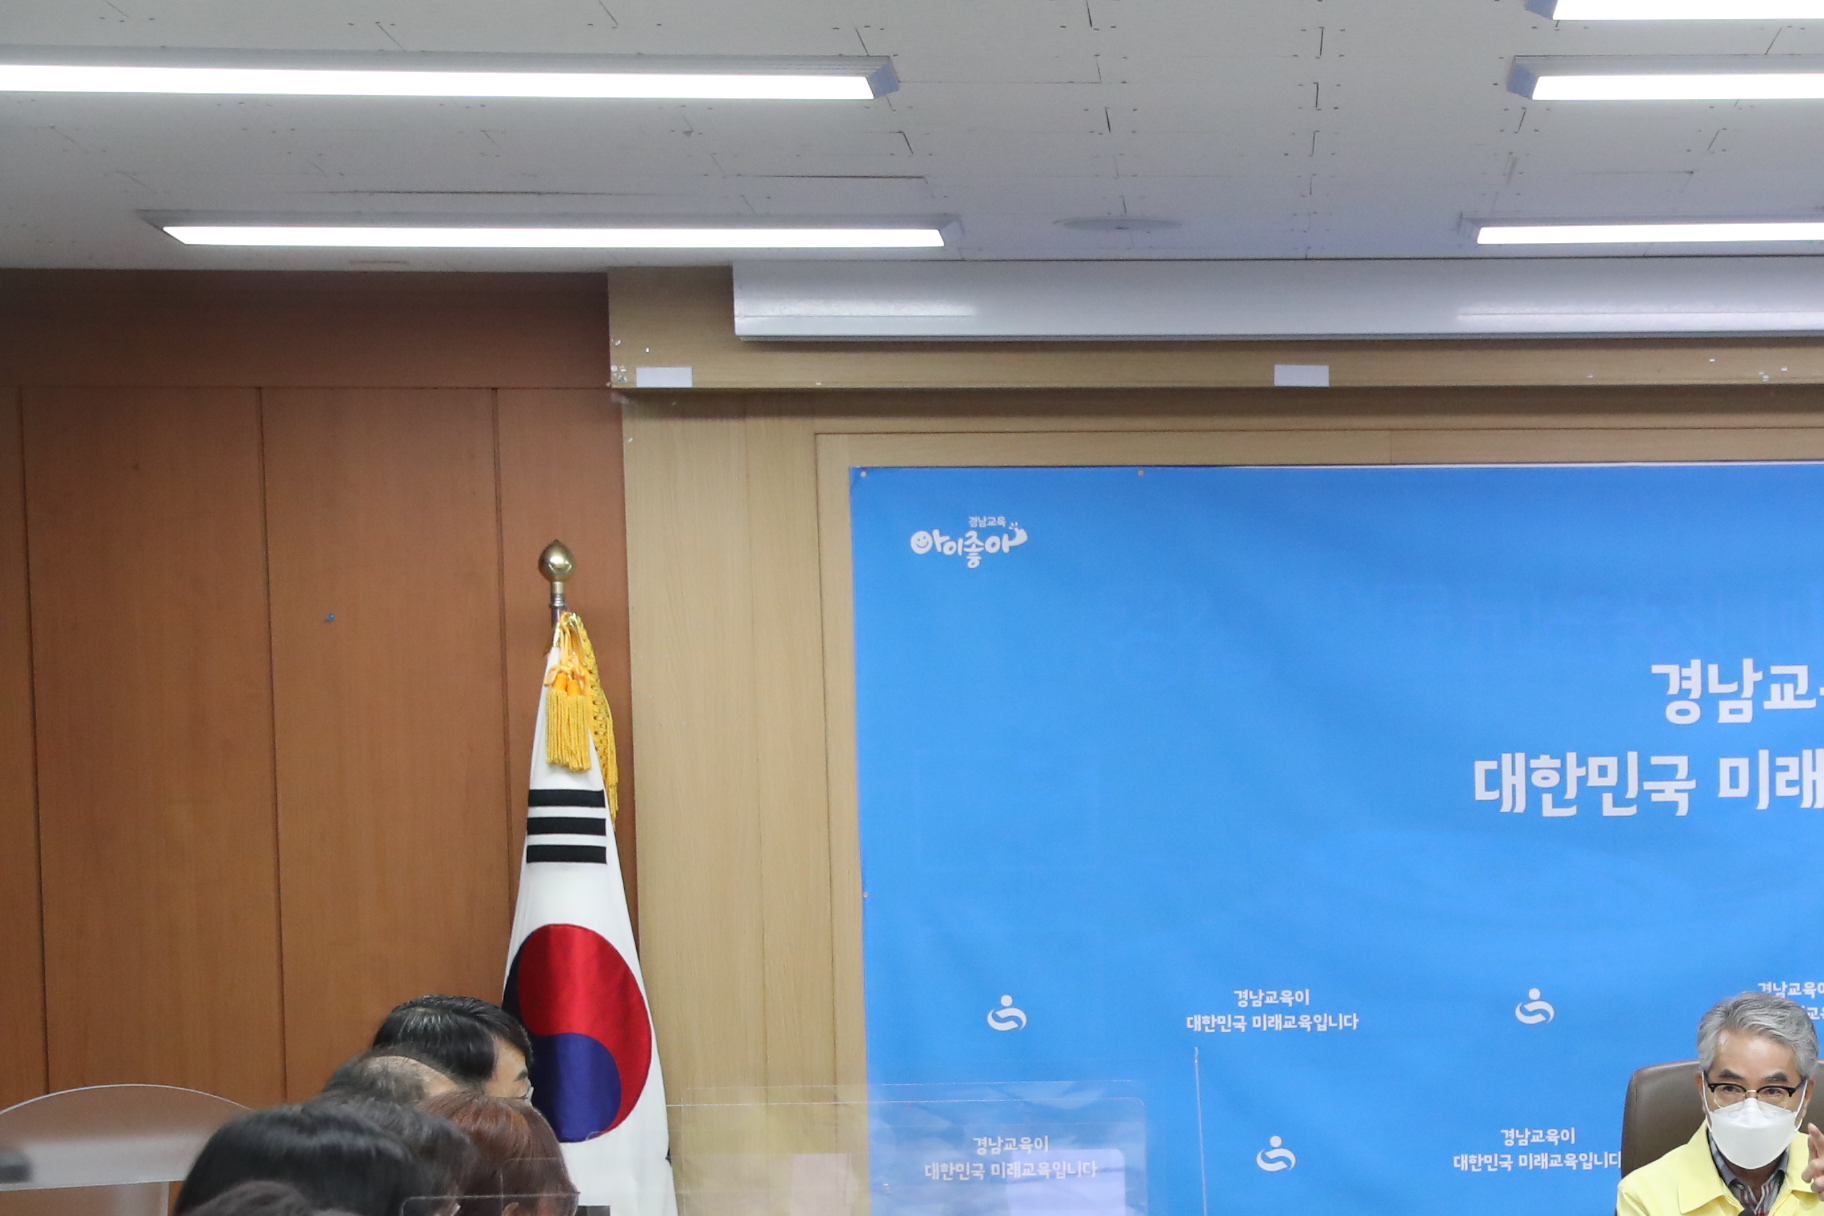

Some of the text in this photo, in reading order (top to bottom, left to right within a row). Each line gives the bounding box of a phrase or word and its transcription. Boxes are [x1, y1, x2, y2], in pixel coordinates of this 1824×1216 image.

[968, 516, 1007, 528] 경남교육
[910, 527, 1029, 569] 아이좋아
[1474, 750, 1697, 818] 대한민국
[1234, 988, 1310, 1008] 경남교육이
[1187, 1012, 1360, 1033] 대한민국 미래교육입니다
[973, 1135, 1049, 1156] 경남교육이
[1500, 1126, 1576, 1147] 경남교육이
[925, 1160, 1098, 1181] 대한민국 미래교육입니다
[1453, 1153, 1514, 1172] 대한민국
